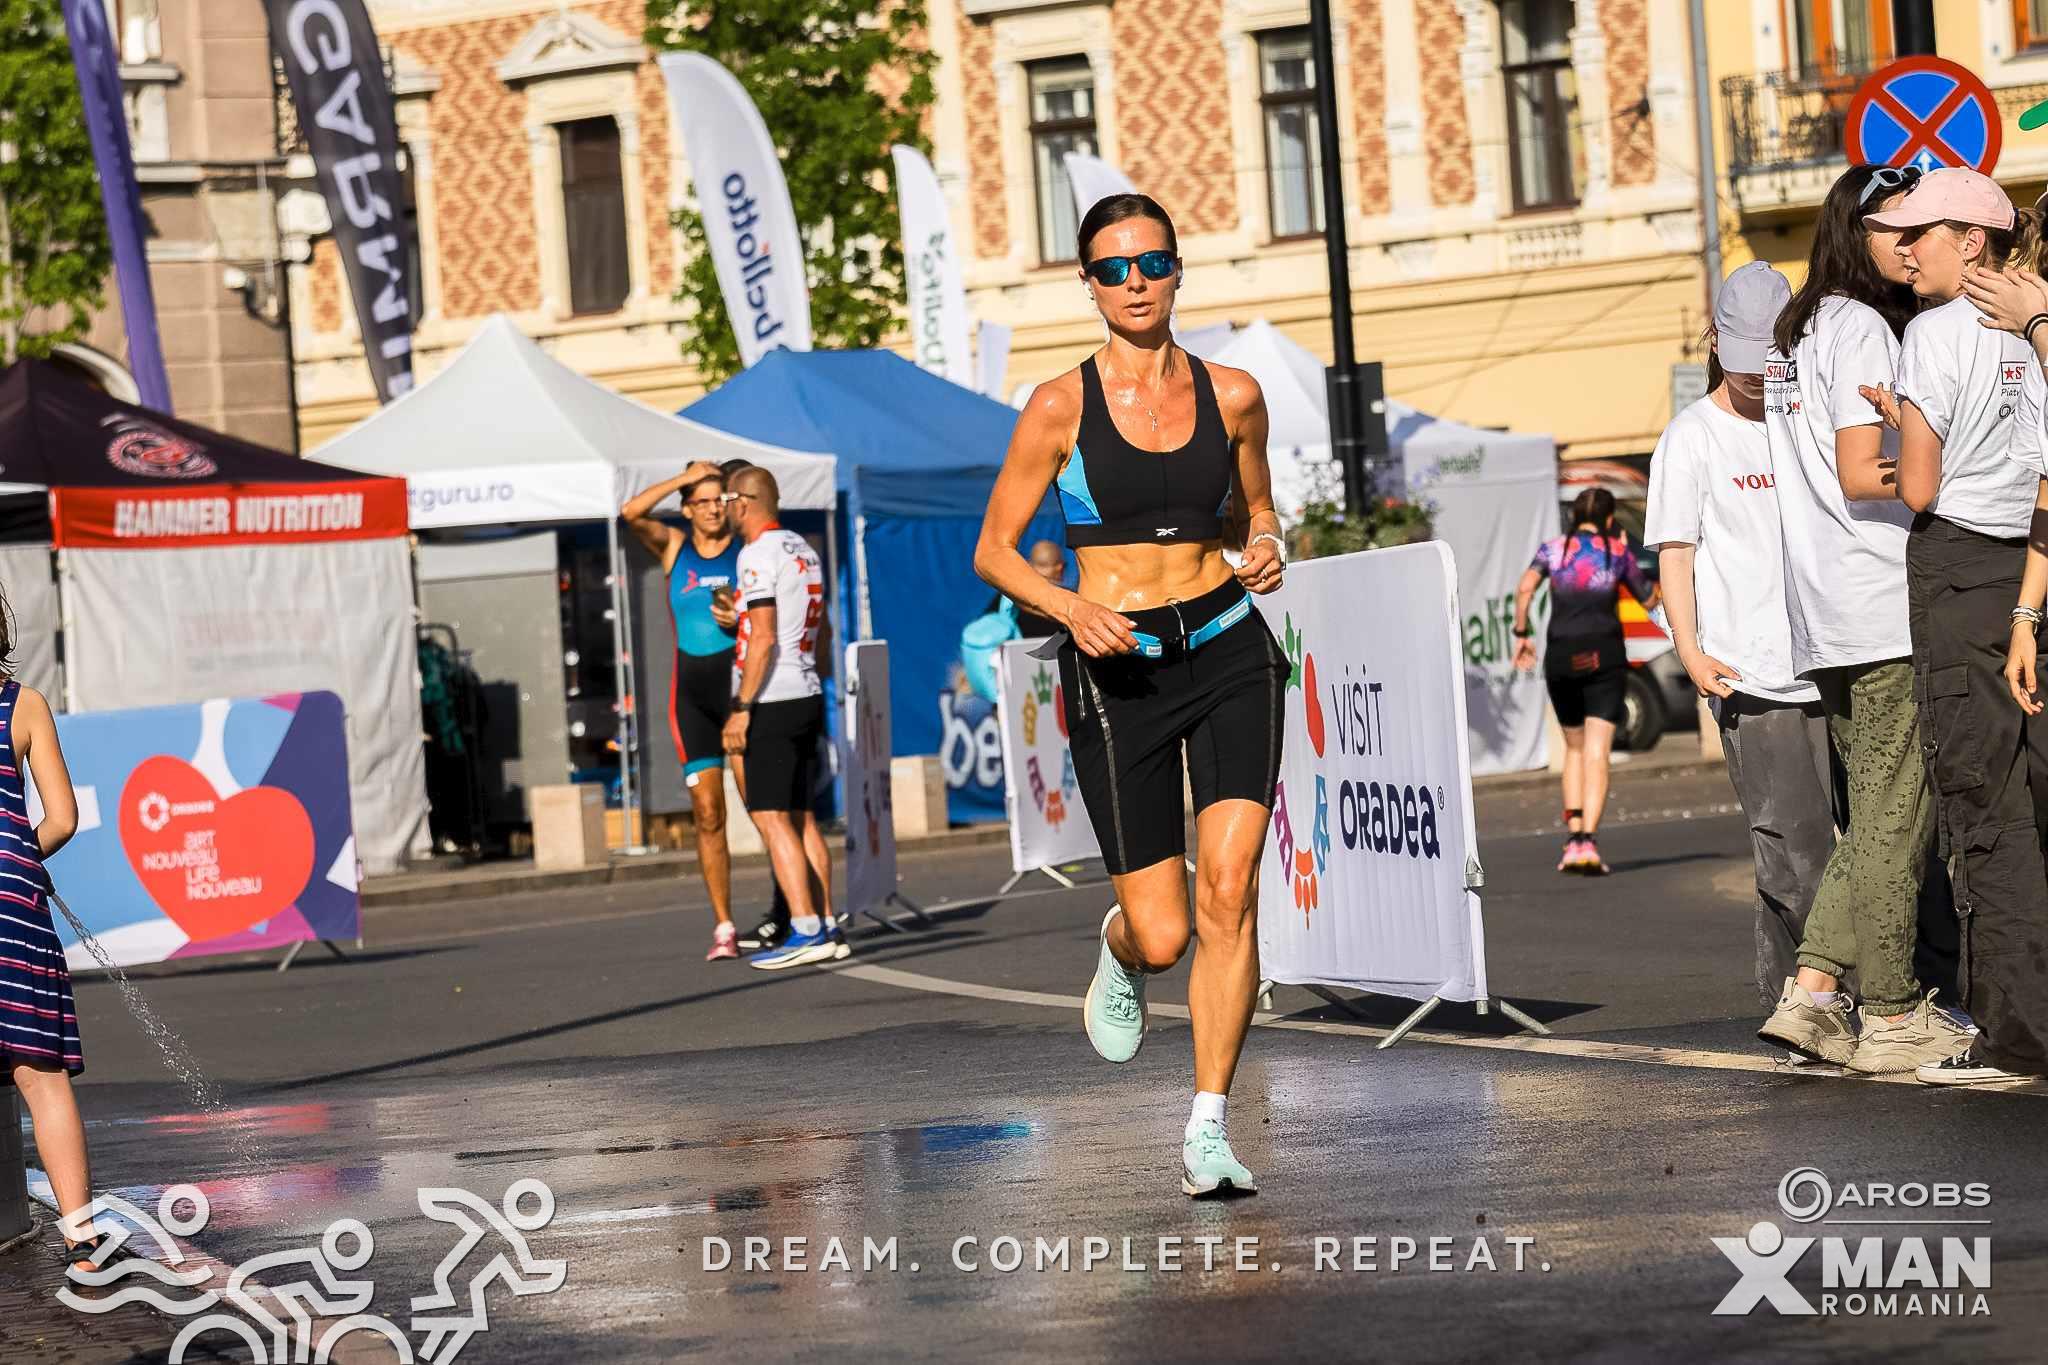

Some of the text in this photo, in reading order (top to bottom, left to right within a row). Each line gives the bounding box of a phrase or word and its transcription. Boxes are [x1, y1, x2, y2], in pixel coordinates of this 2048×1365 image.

[113, 492, 364, 538] HAMMER NUTRITION
[938, 692, 1003, 788] be
